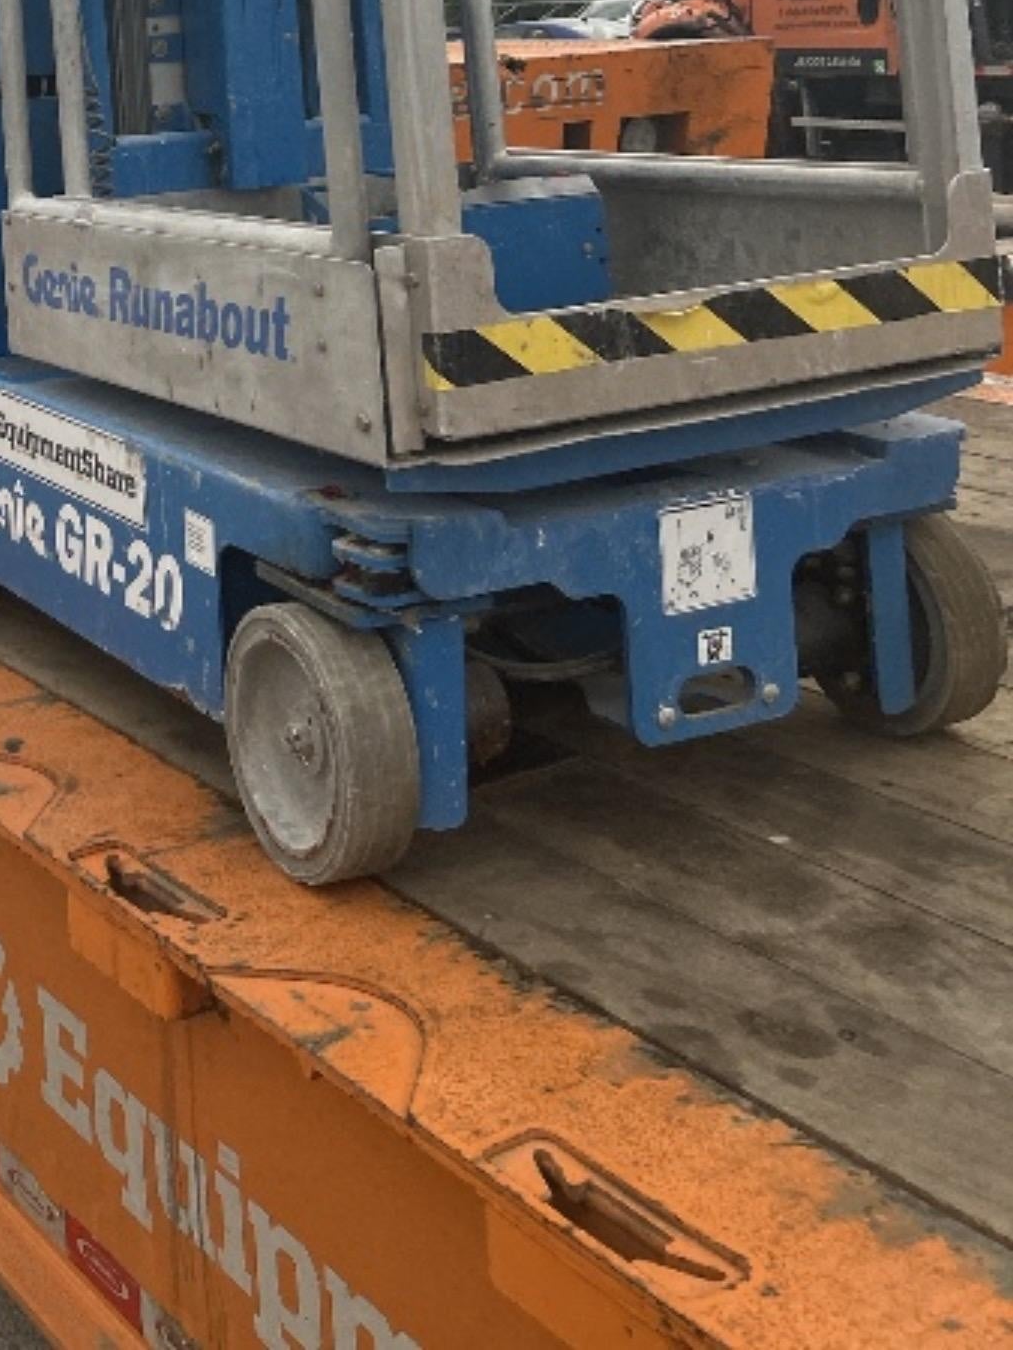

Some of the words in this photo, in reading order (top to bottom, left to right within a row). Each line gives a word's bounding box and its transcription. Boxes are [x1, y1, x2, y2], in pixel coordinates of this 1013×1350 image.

[22, 254, 99, 318] Genie
[109, 266, 290, 360] Runabout
[55, 503, 184, 631] GR-20
